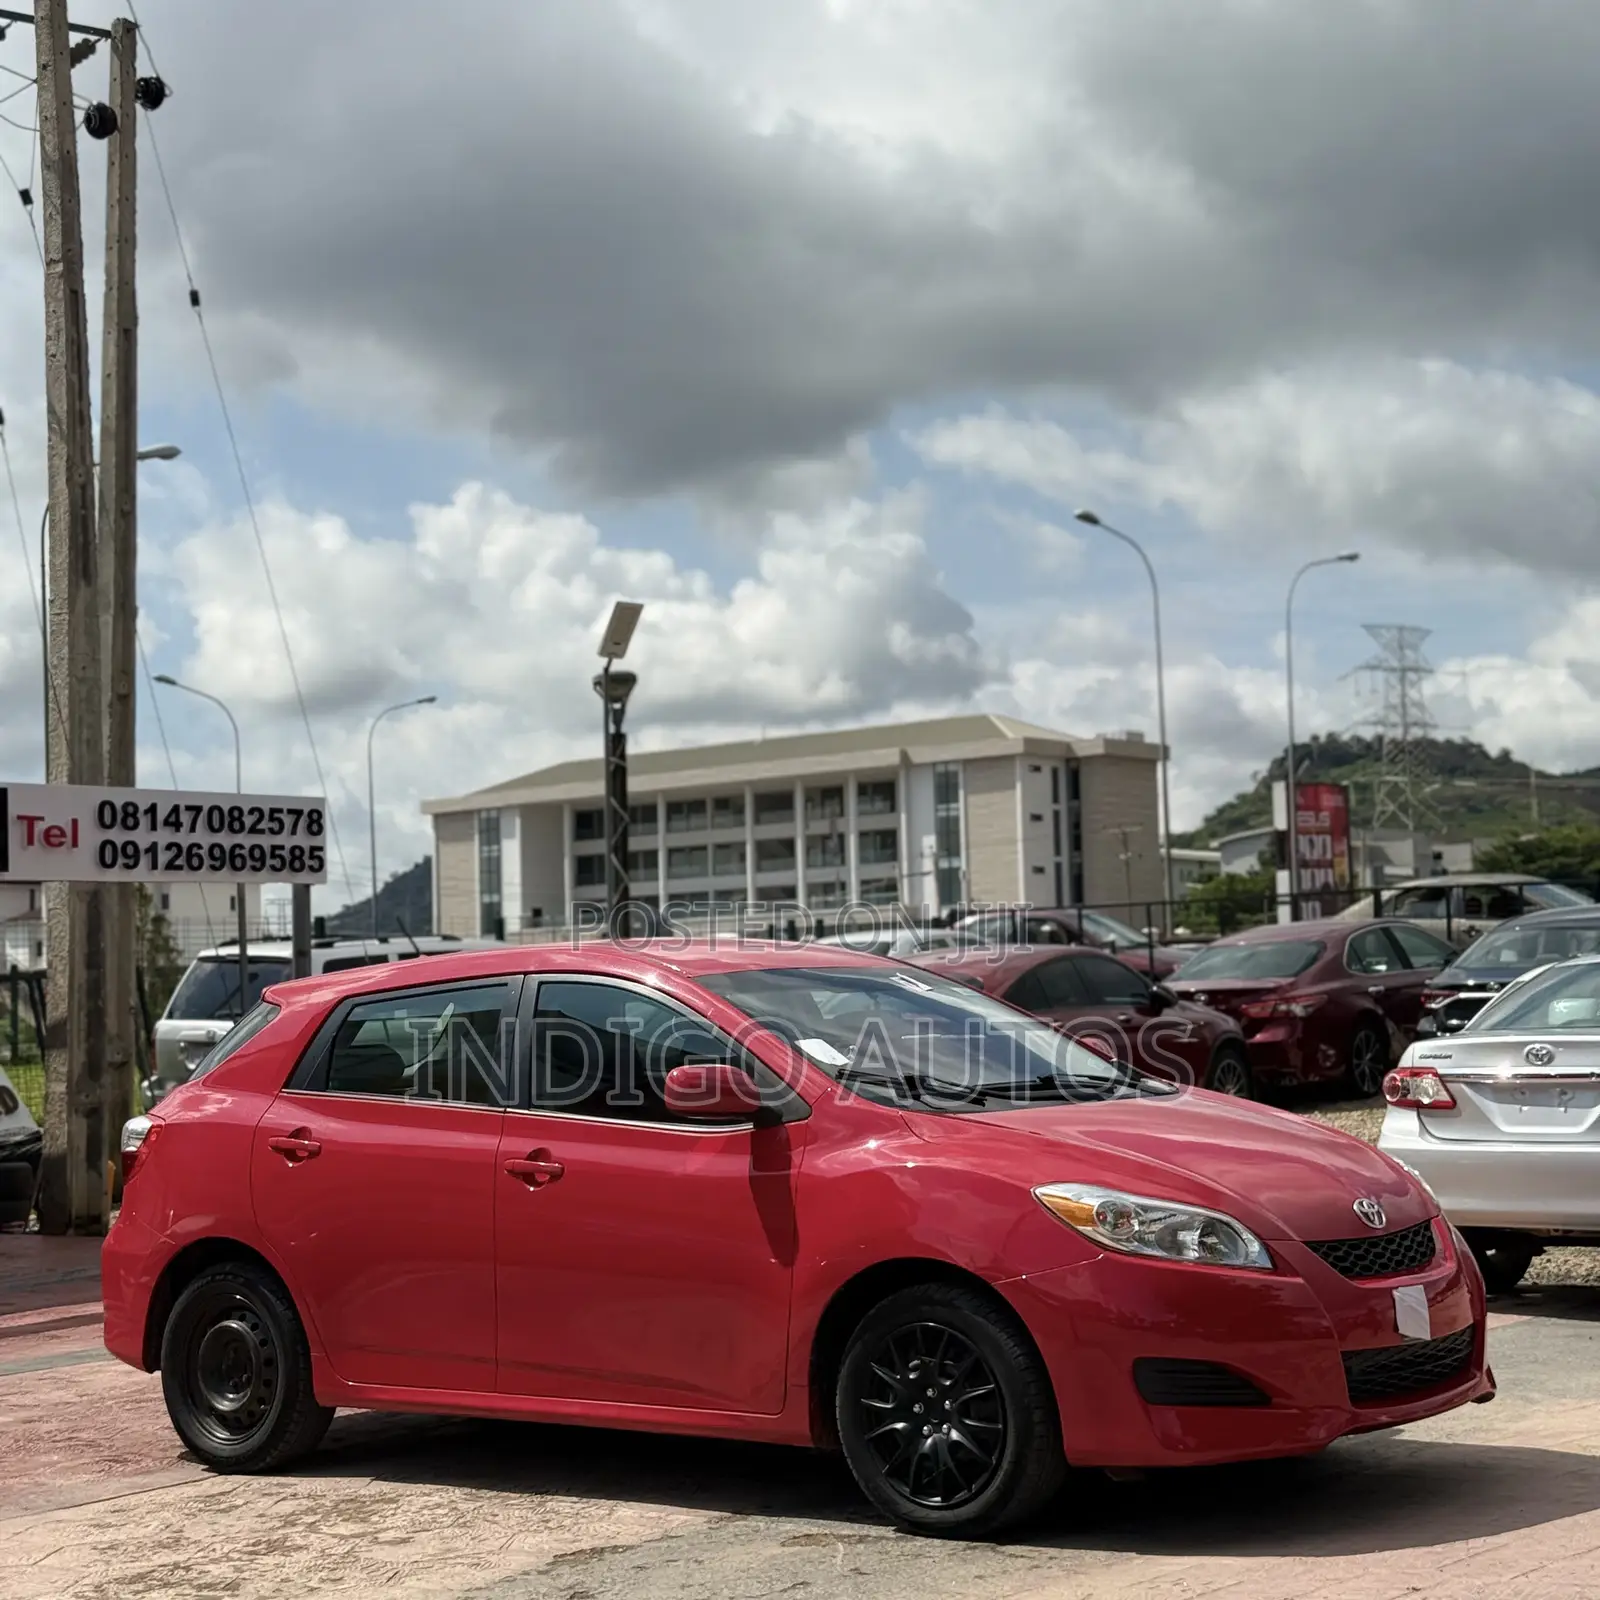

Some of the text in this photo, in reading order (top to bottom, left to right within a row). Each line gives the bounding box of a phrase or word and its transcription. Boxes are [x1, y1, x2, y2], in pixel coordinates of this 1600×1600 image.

[16, 815, 79, 849] Tel
[97, 800, 324, 836] 08147082578
[98, 839, 325, 873] 09126969585
